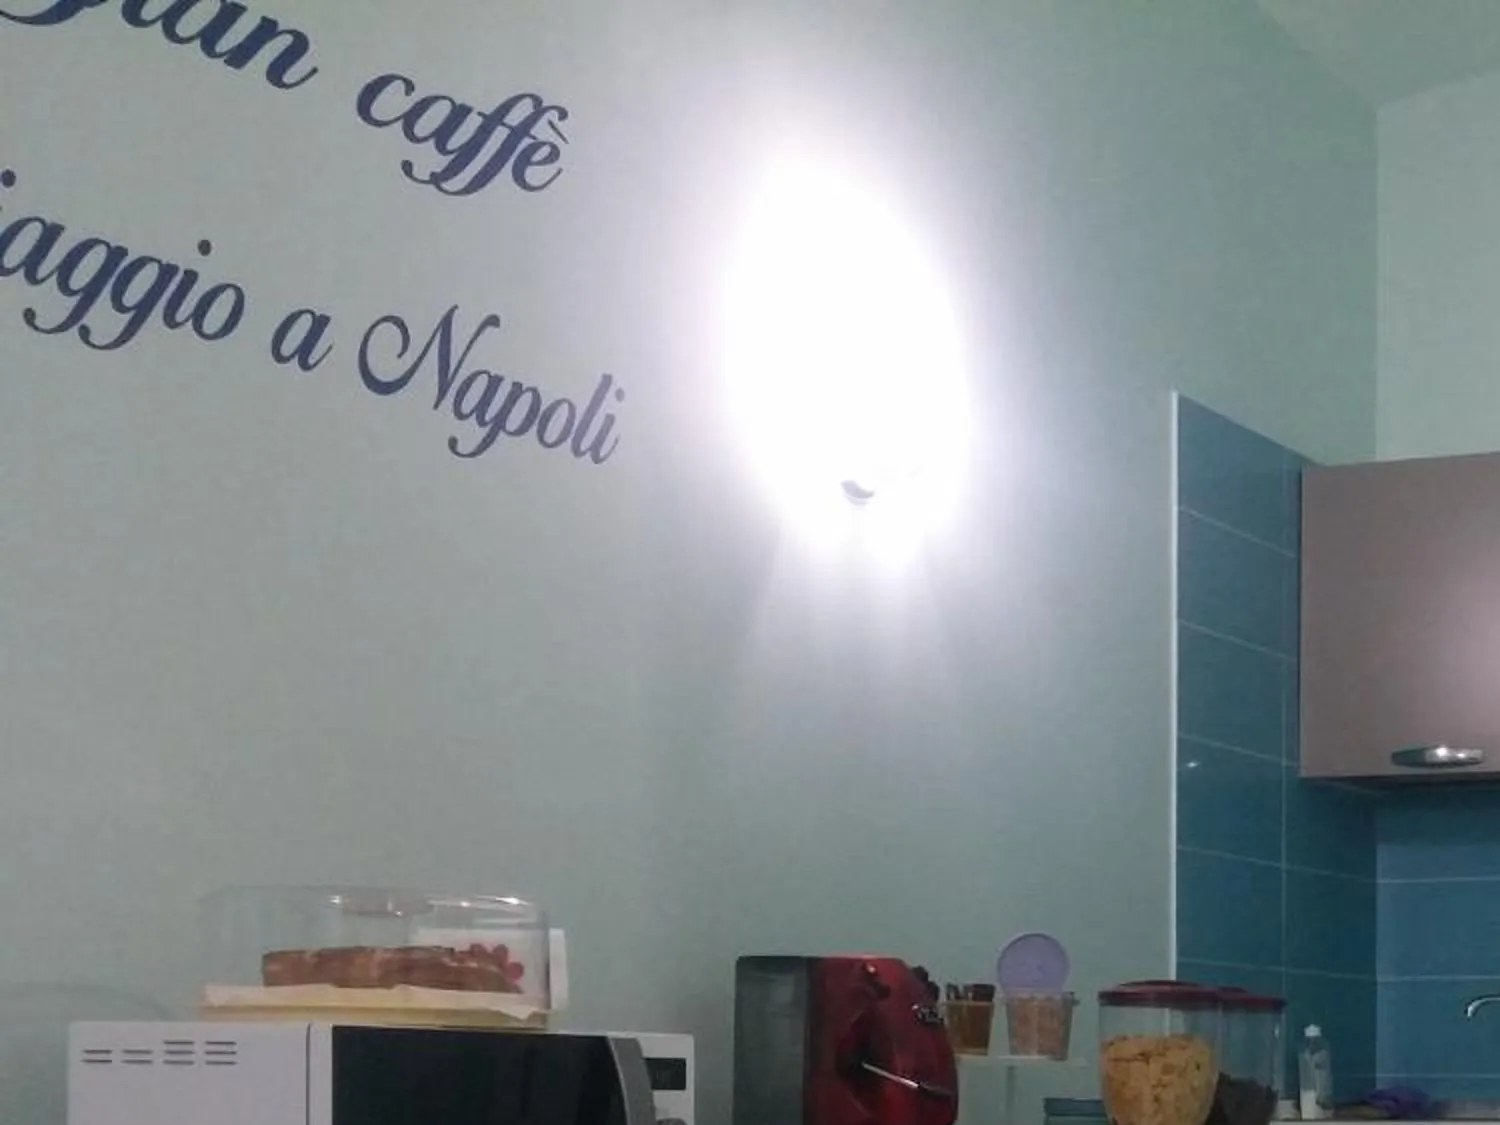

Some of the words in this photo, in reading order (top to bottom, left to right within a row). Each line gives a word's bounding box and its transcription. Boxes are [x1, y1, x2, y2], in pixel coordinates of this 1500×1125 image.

[357, 74, 568, 196] caffè
[0, 169, 245, 350] aggio
[272, 309, 332, 371] a
[358, 304, 625, 464] Napoli
